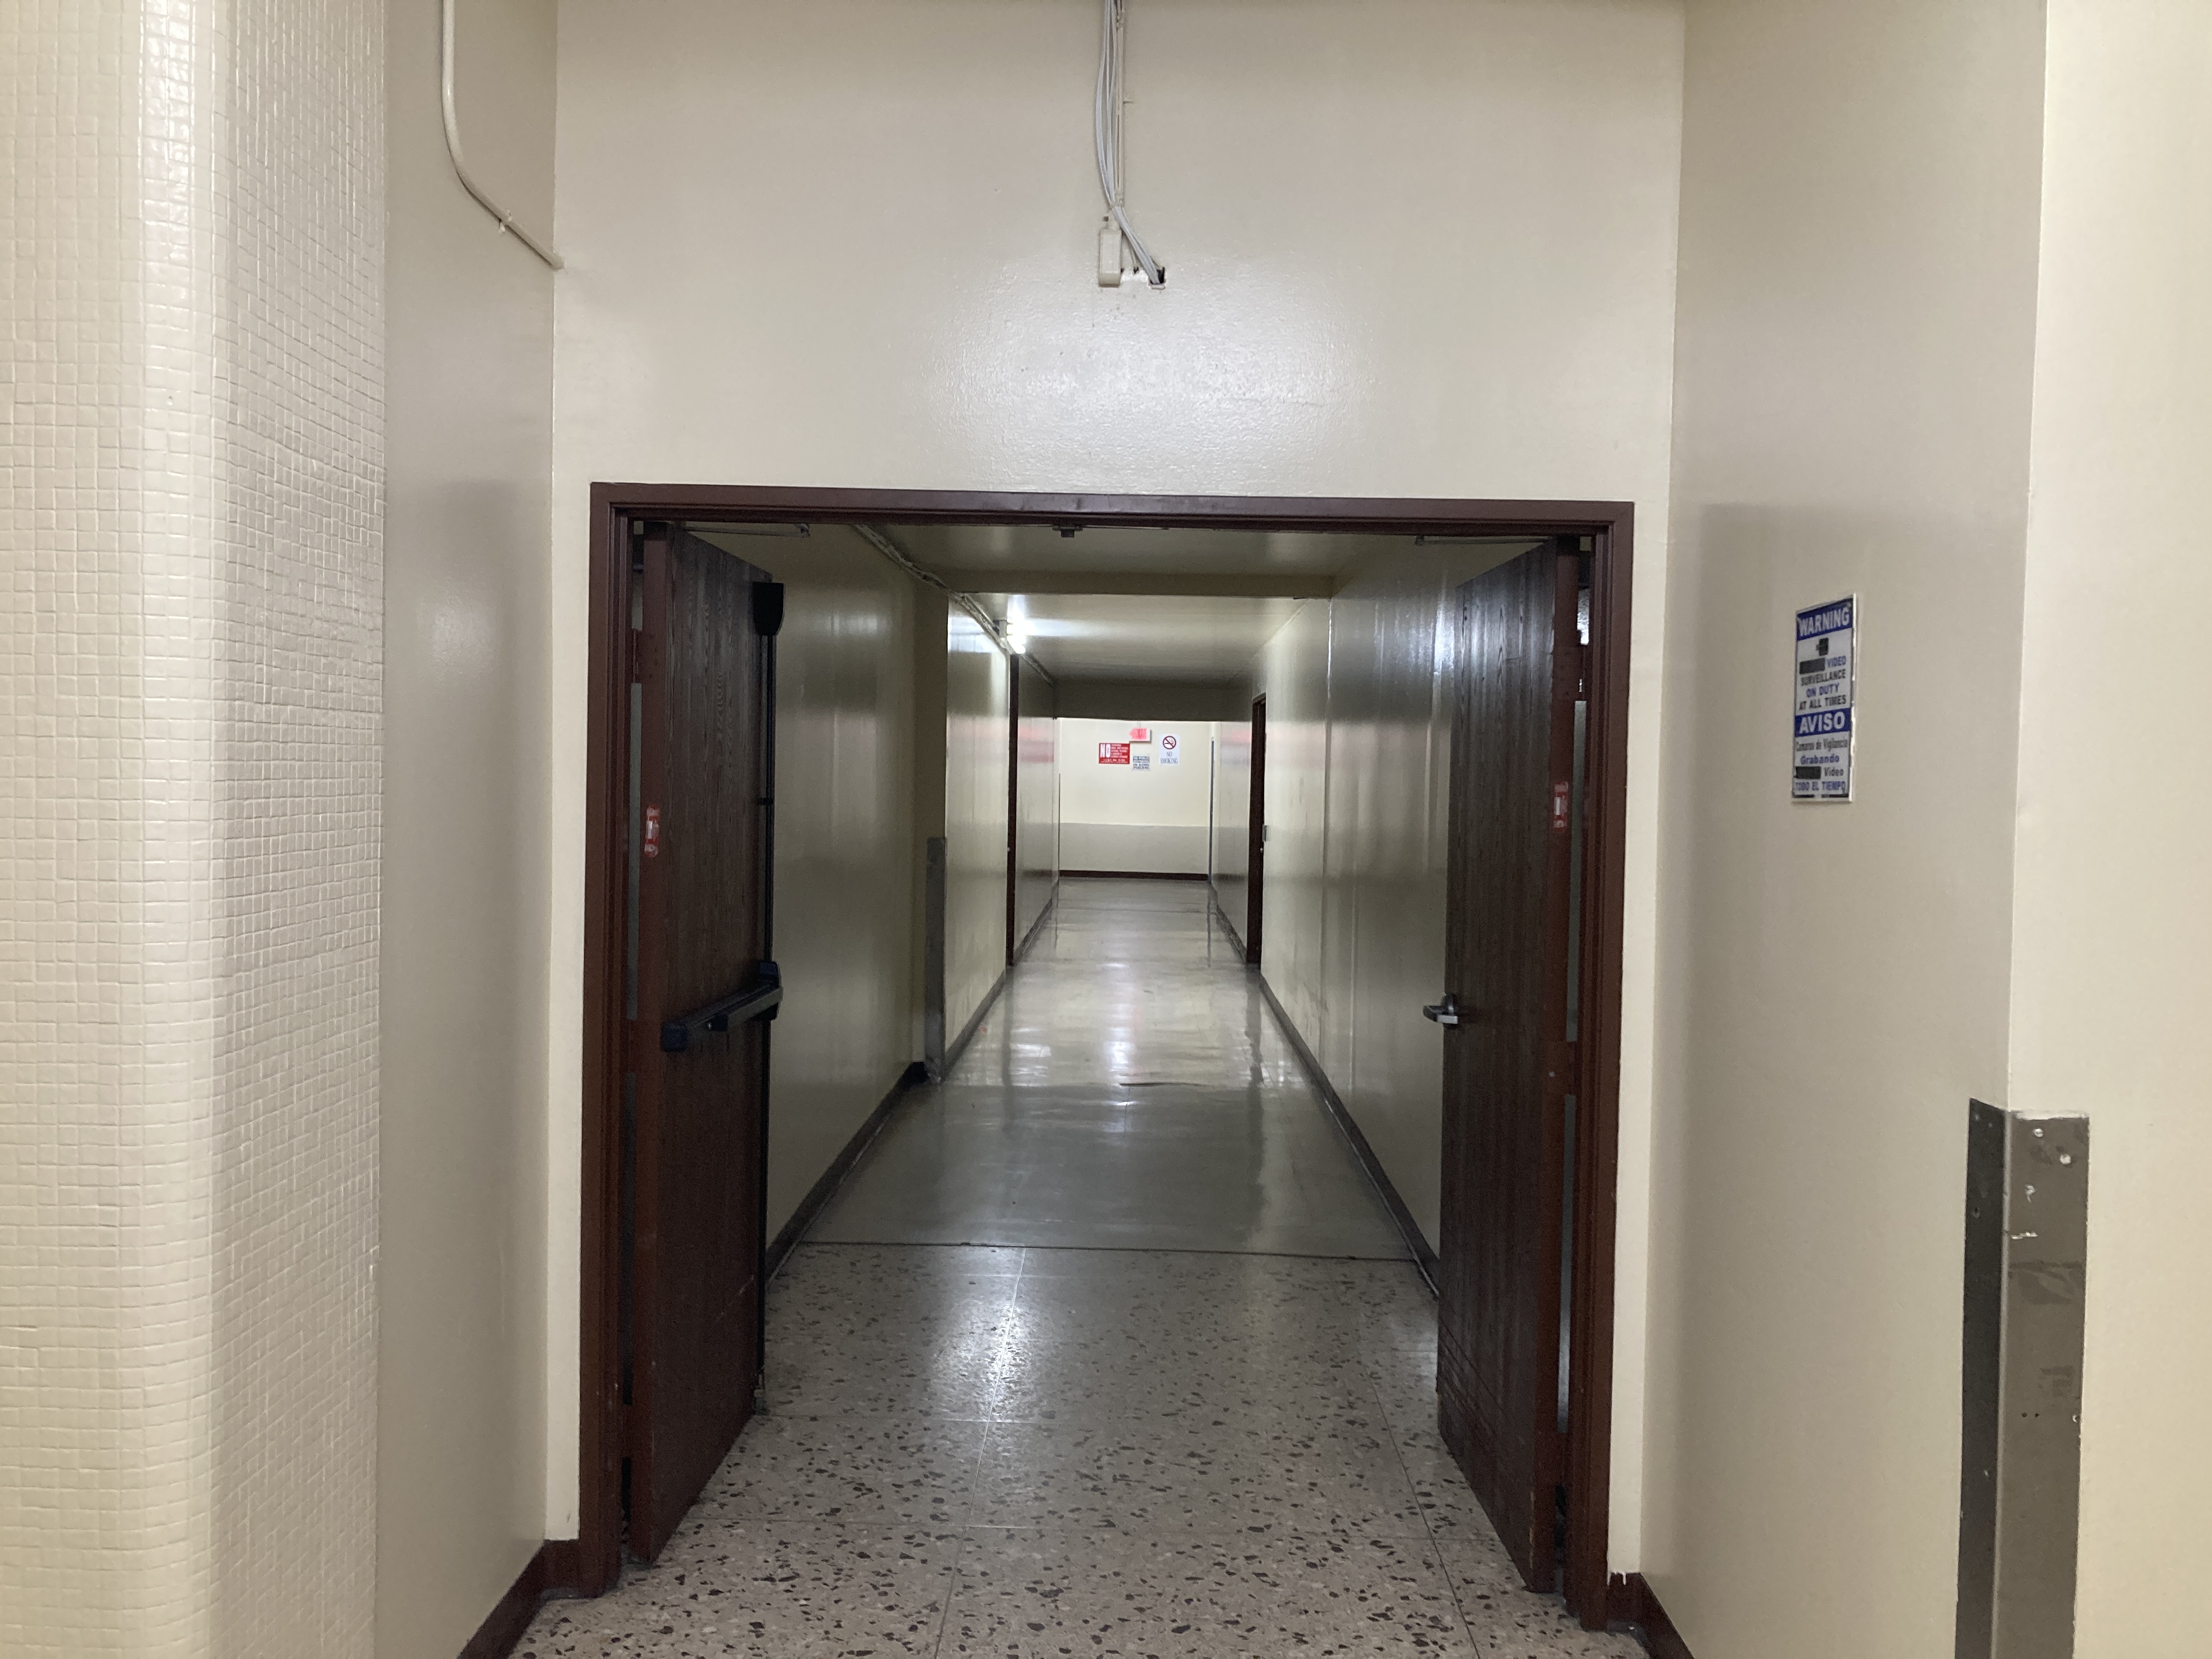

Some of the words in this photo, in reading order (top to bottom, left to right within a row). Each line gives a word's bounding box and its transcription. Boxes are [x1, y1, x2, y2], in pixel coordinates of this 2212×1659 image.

[1799, 607, 1850, 636] WARNING
[1827, 656, 1847, 668] VIDEO
[1801, 668, 1846, 686] SURVEILLANCE
[1807, 688, 1816, 698] ON
[1820, 683, 1839, 696] DUTY
[1799, 701, 1808, 710] AT
[1809, 698, 1821, 708] ALL
[1825, 695, 1847, 706] TIMES
[1799, 711, 1846, 734] AVISO
[1100, 743, 1111, 758] NO
[1815, 738, 1822, 750] de
[1801, 753, 1839, 765] Grabando
[1824, 766, 1844, 777] Video
[1812, 781, 1819, 791] EL
[1821, 781, 1846, 791] TIEMPO
